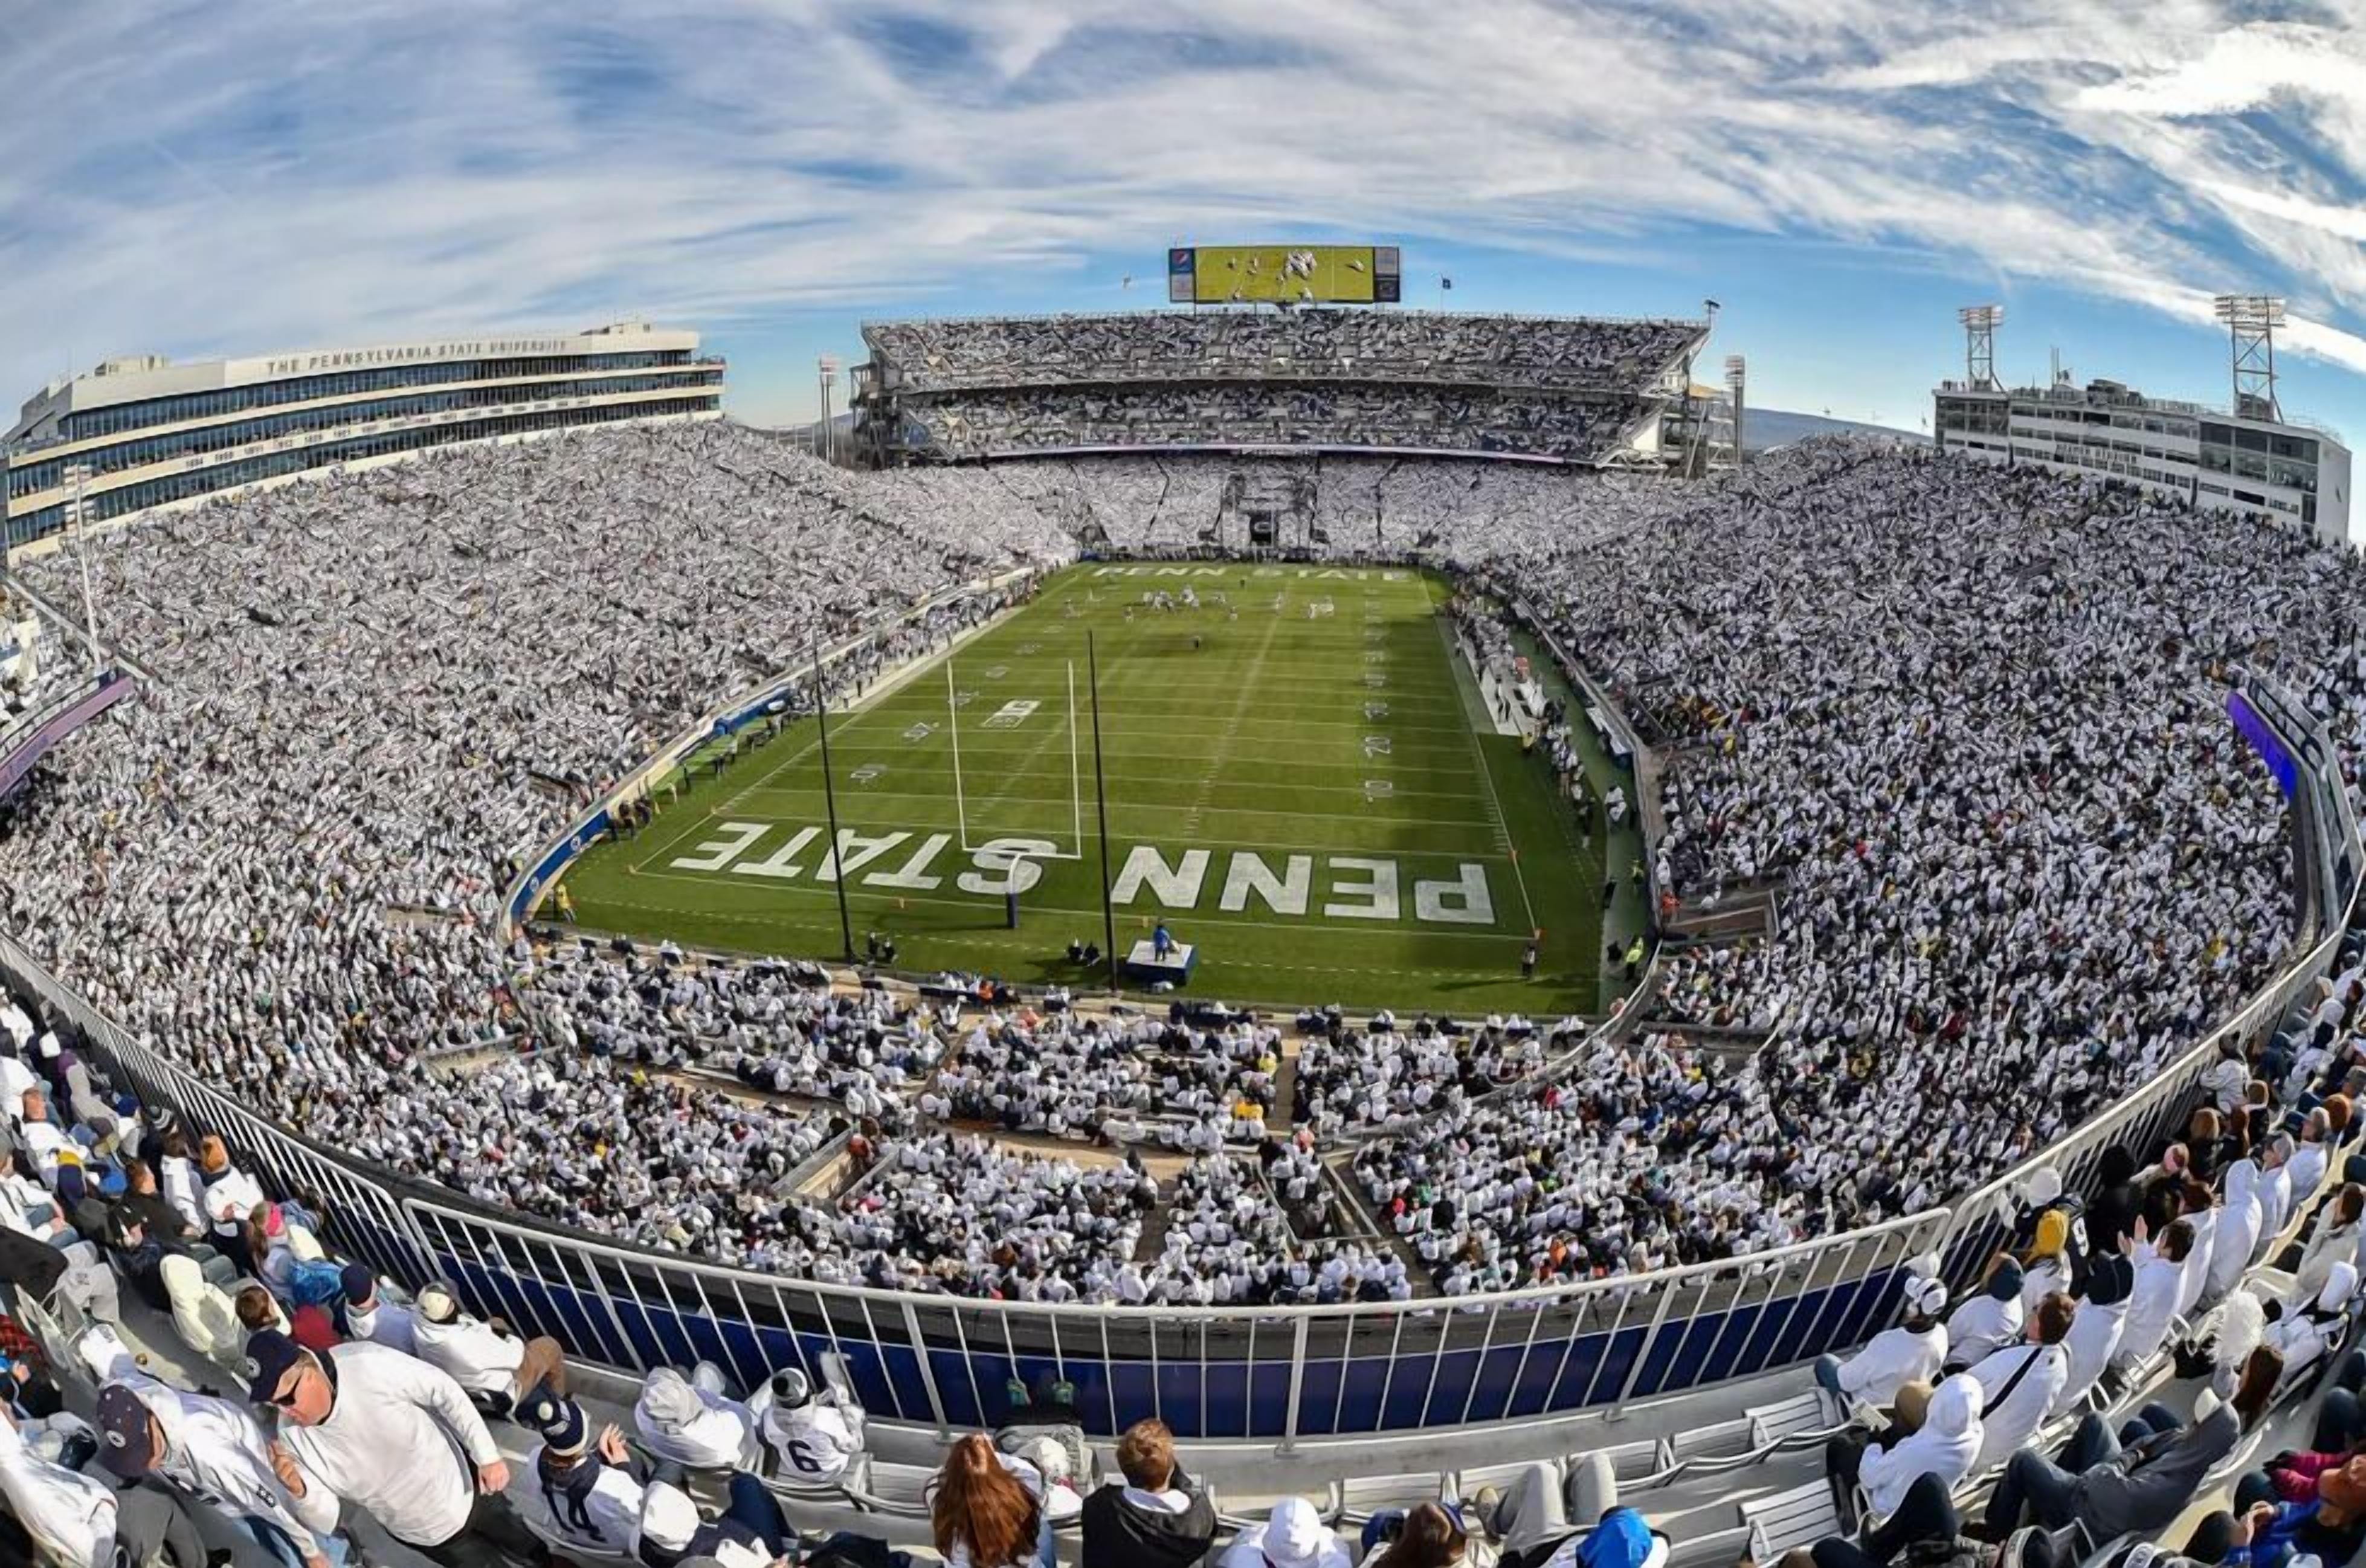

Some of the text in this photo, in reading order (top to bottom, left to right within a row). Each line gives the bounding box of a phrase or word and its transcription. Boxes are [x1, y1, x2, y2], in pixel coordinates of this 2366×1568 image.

[268, 339, 566, 374] THE PENNSYLVANIA STATE UNIVERSITY
[669, 821, 1497, 925] PENN STATE
[2073, 1216, 2090, 1257] 9
[788, 1439, 822, 1473] 6
